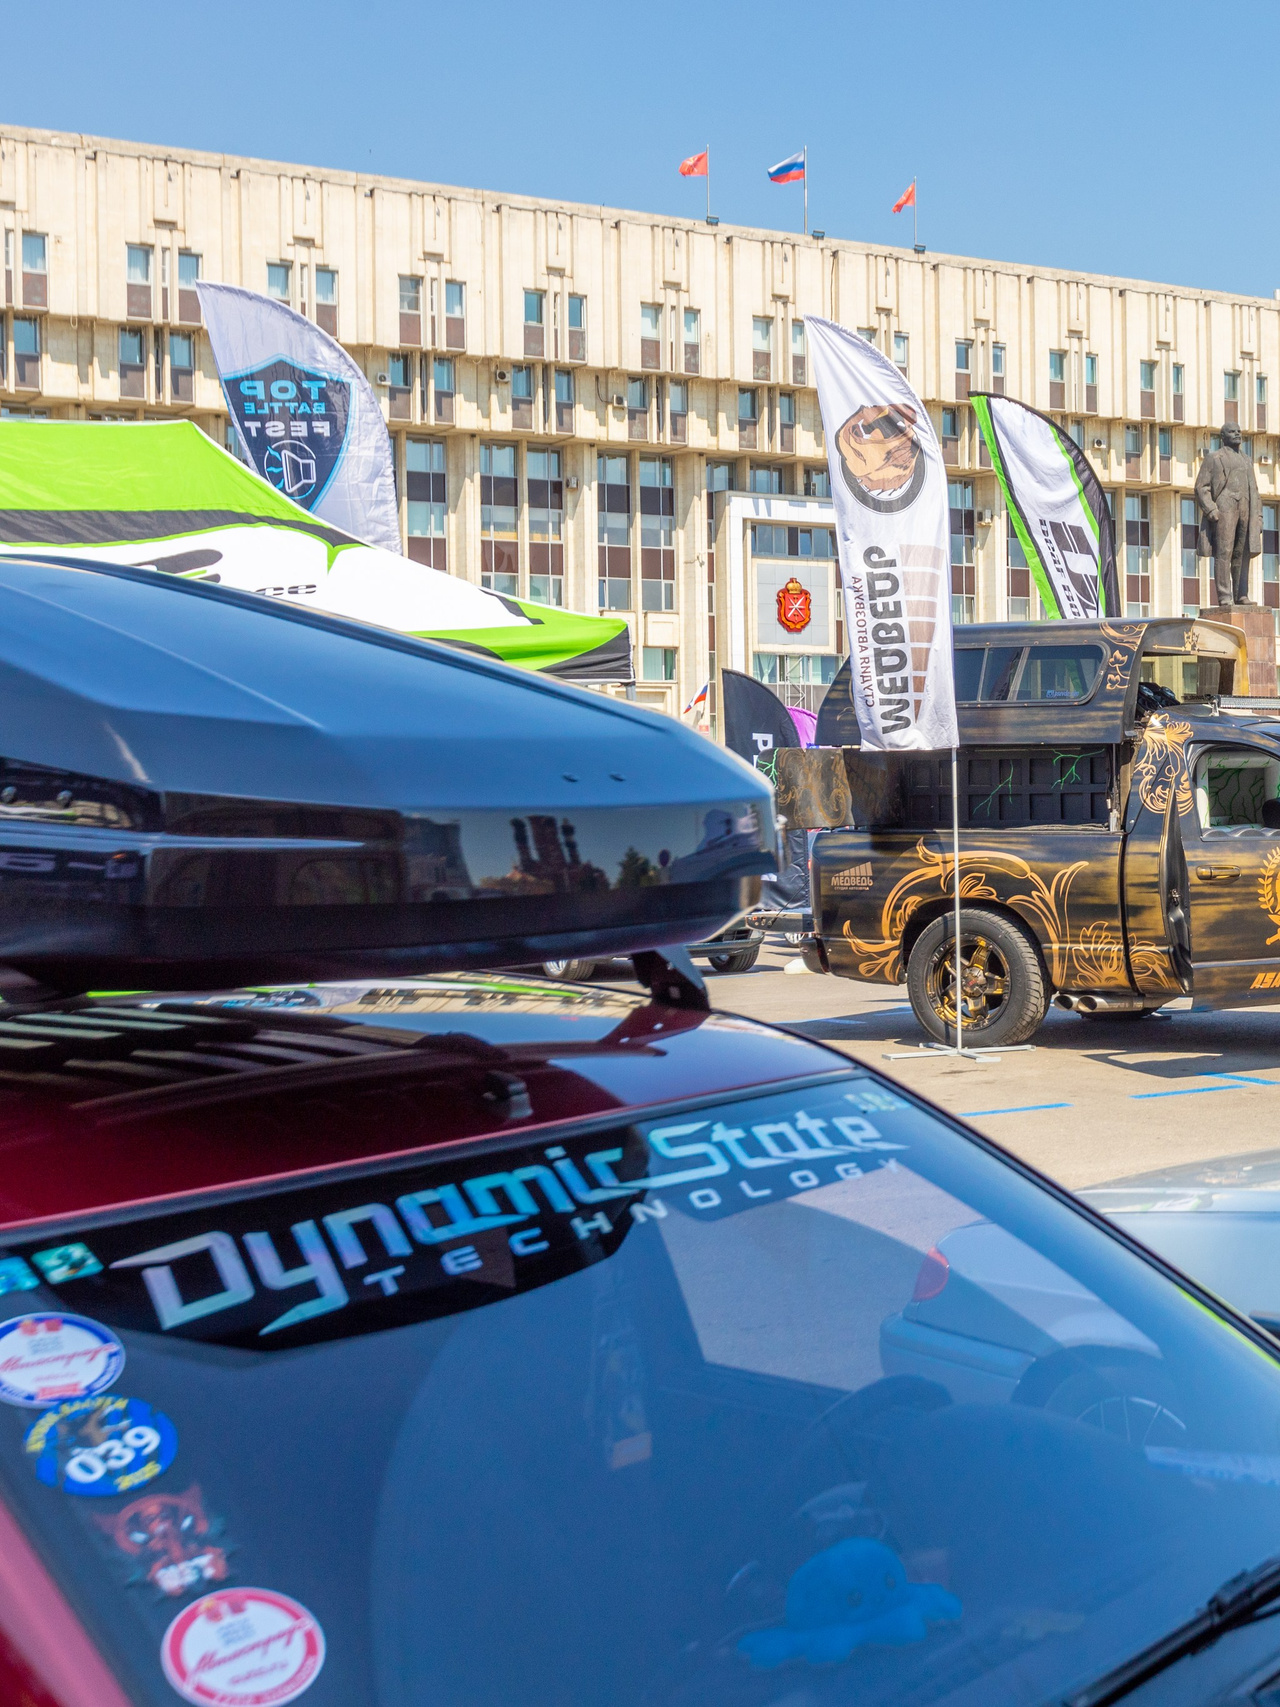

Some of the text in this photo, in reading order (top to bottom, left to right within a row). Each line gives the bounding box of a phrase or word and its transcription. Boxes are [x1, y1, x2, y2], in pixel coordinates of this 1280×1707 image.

[1061, 584, 1082, 619] BO
[831, 876, 874, 886] МЕДВЕДЬ
[109, 1109, 910, 1335] Dynamic State
[364, 1157, 903, 1297] TECHNOLOGY
[65, 1425, 161, 1484] 039
